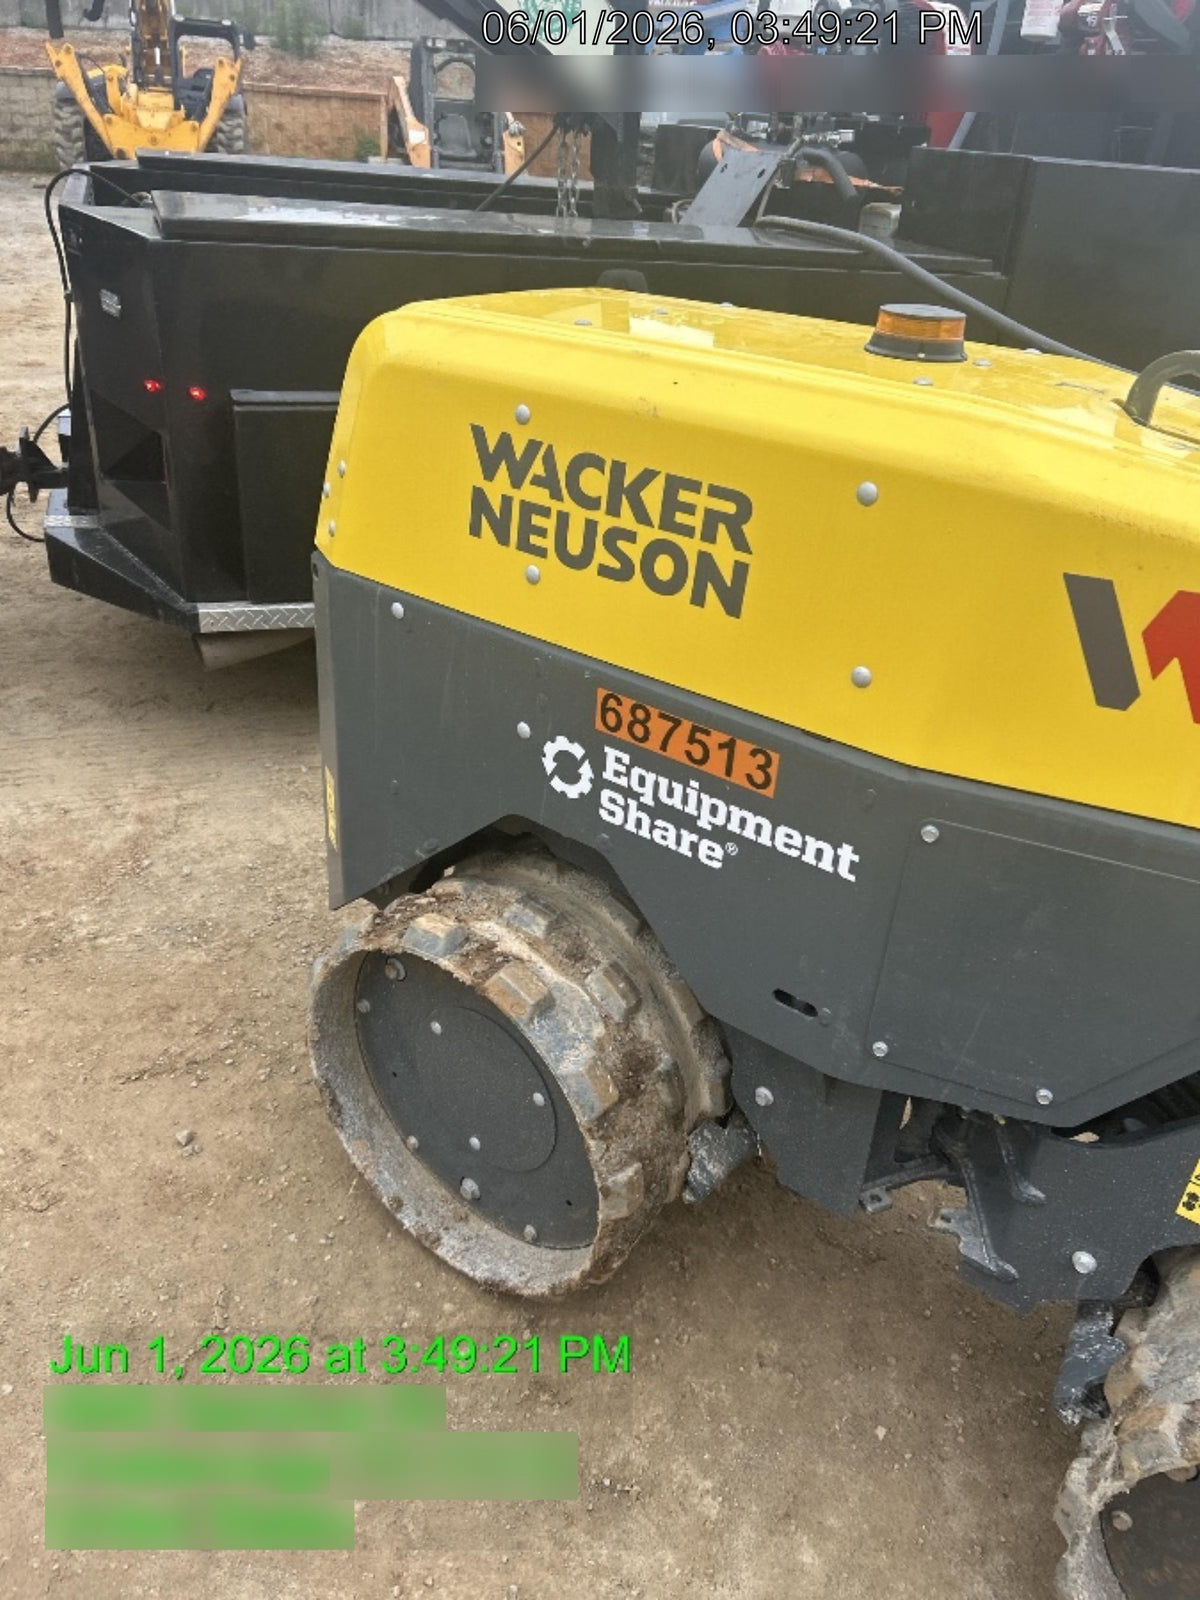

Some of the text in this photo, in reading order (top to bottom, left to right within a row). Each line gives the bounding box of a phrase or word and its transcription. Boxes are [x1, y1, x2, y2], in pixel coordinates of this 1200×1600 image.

[469, 423, 753, 555] WACKER
[469, 485, 750, 619] NEUSON
[600, 693, 772, 790] 687513
[602, 745, 860, 882] Equipment
